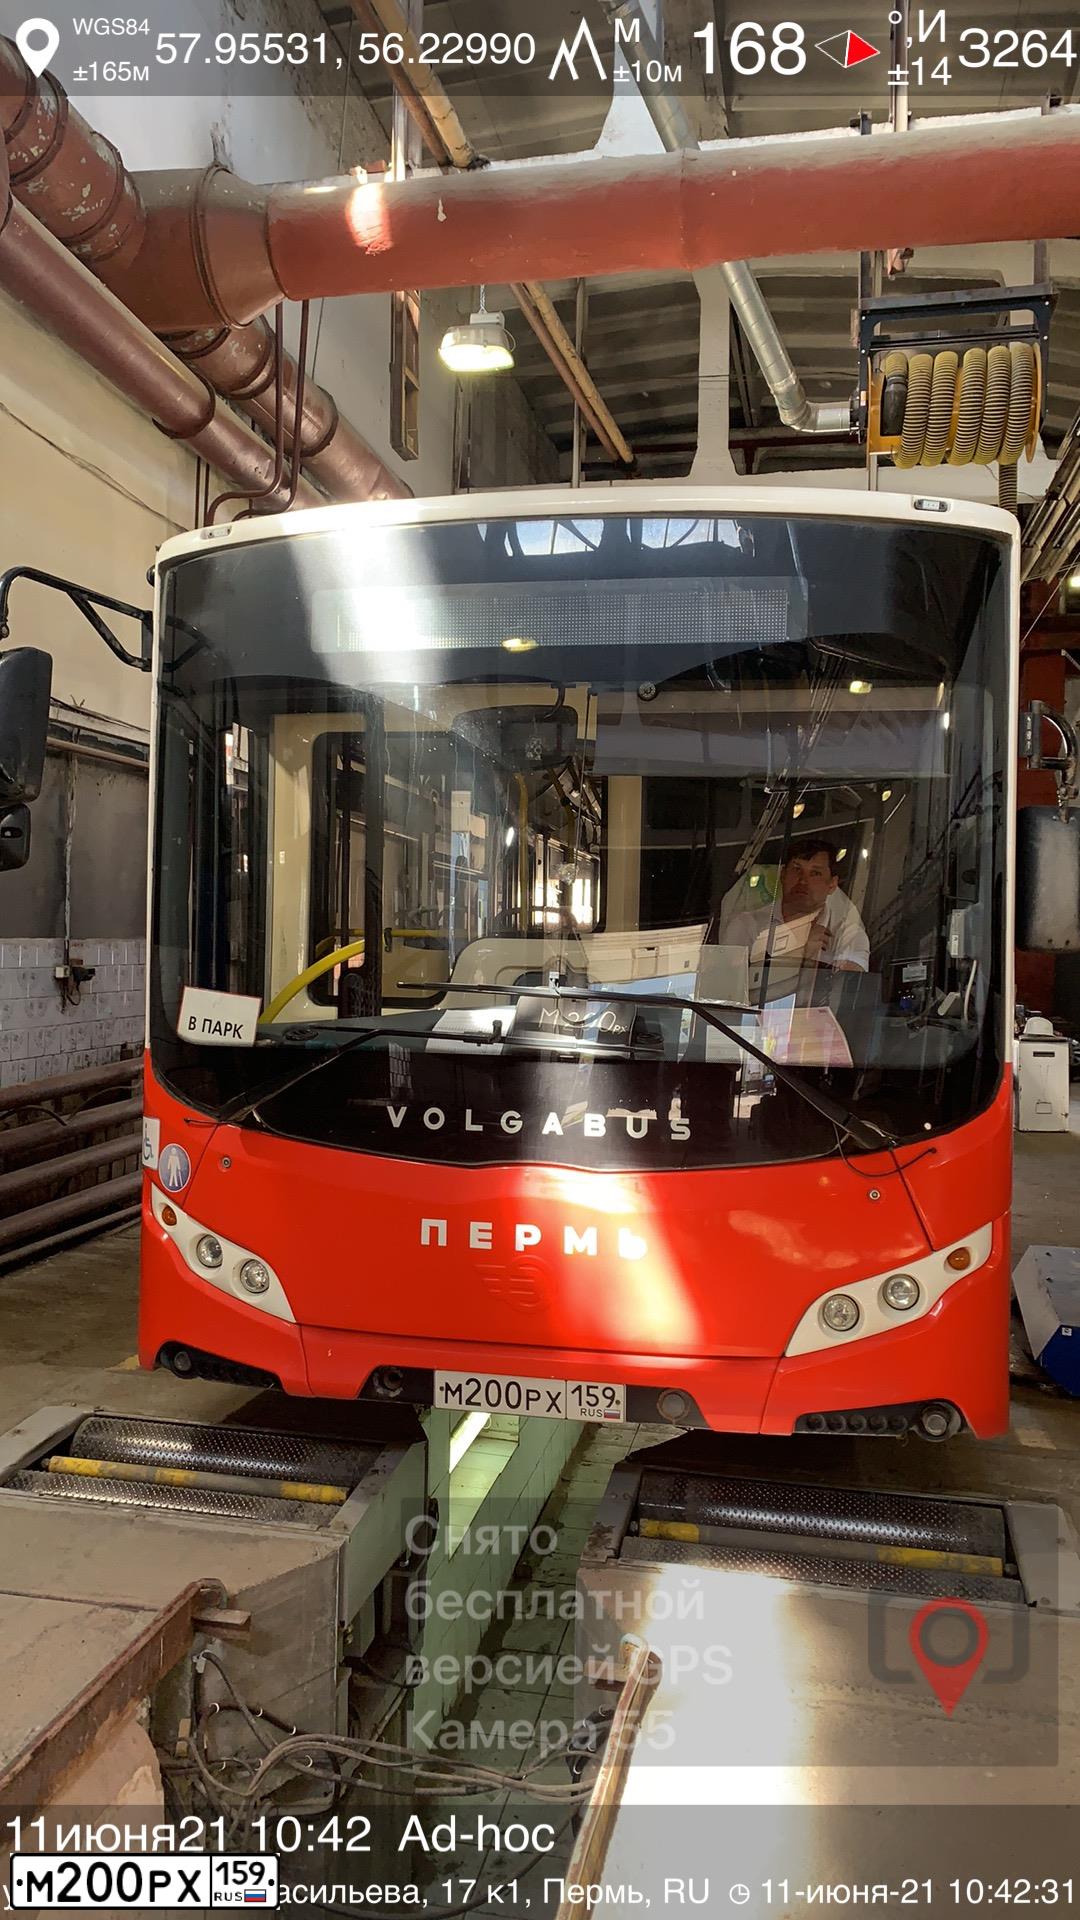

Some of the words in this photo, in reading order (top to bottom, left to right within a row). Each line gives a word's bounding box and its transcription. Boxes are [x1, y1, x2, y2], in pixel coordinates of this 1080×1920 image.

[188, 1015, 197, 1031] В
[201, 1018, 244, 1040] ПАРК
[387, 1105, 691, 1141] VOLGABUS
[420, 1218, 648, 1261] ПЕРМЬ
[570, 1384, 617, 1409] 159
[580, 1407, 603, 1418] RUS
